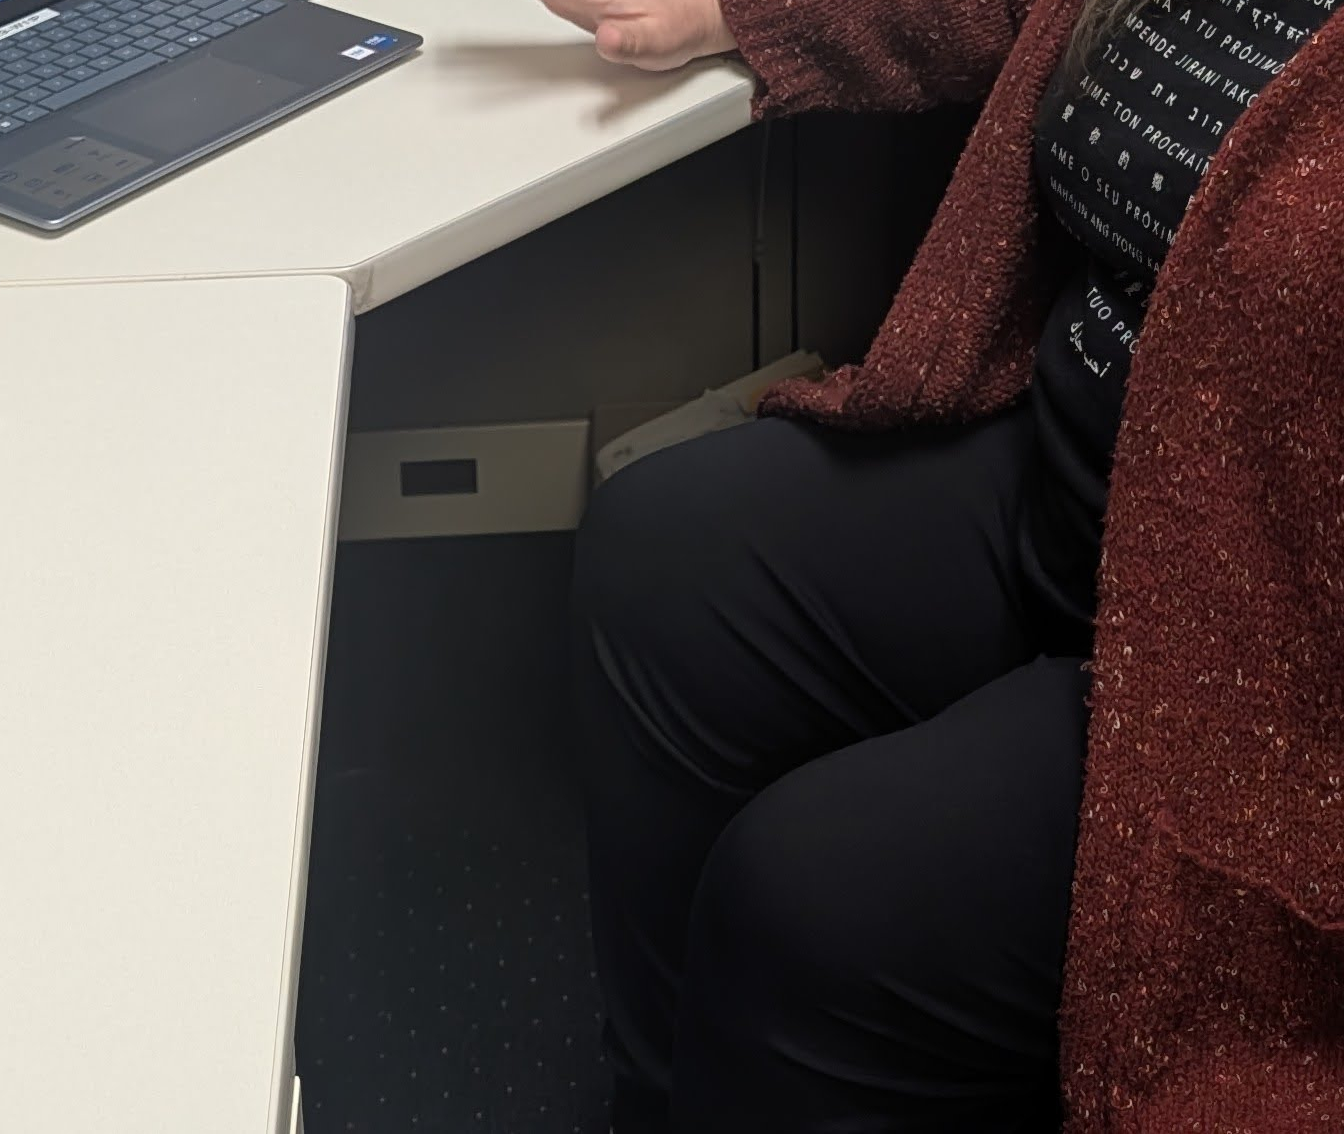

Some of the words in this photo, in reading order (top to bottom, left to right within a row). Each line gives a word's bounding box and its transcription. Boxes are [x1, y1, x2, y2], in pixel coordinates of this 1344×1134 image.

[1123, 12, 1177, 59] MPENDE
[1175, 54, 1222, 87] JIRANI
[1179, 9, 1192, 25] A
[1197, 18, 1218, 40] TU
[1220, 34, 1286, 76] PRÓJIMO
[1079, 75, 1111, 108] AIME
[1113, 100, 1142, 130] TON
[1141, 124, 1210, 177] PROCHAIN
[1188, 106, 1223, 136] הוב
[1050, 142, 1075, 171] AME
[1080, 166, 1090, 182] O
[1095, 177, 1120, 207] SEU
[1125, 199, 1177, 247] PRÓXIM
[1090, 215, 1110, 239] ANG
[1086, 286, 1112, 321] TUO
